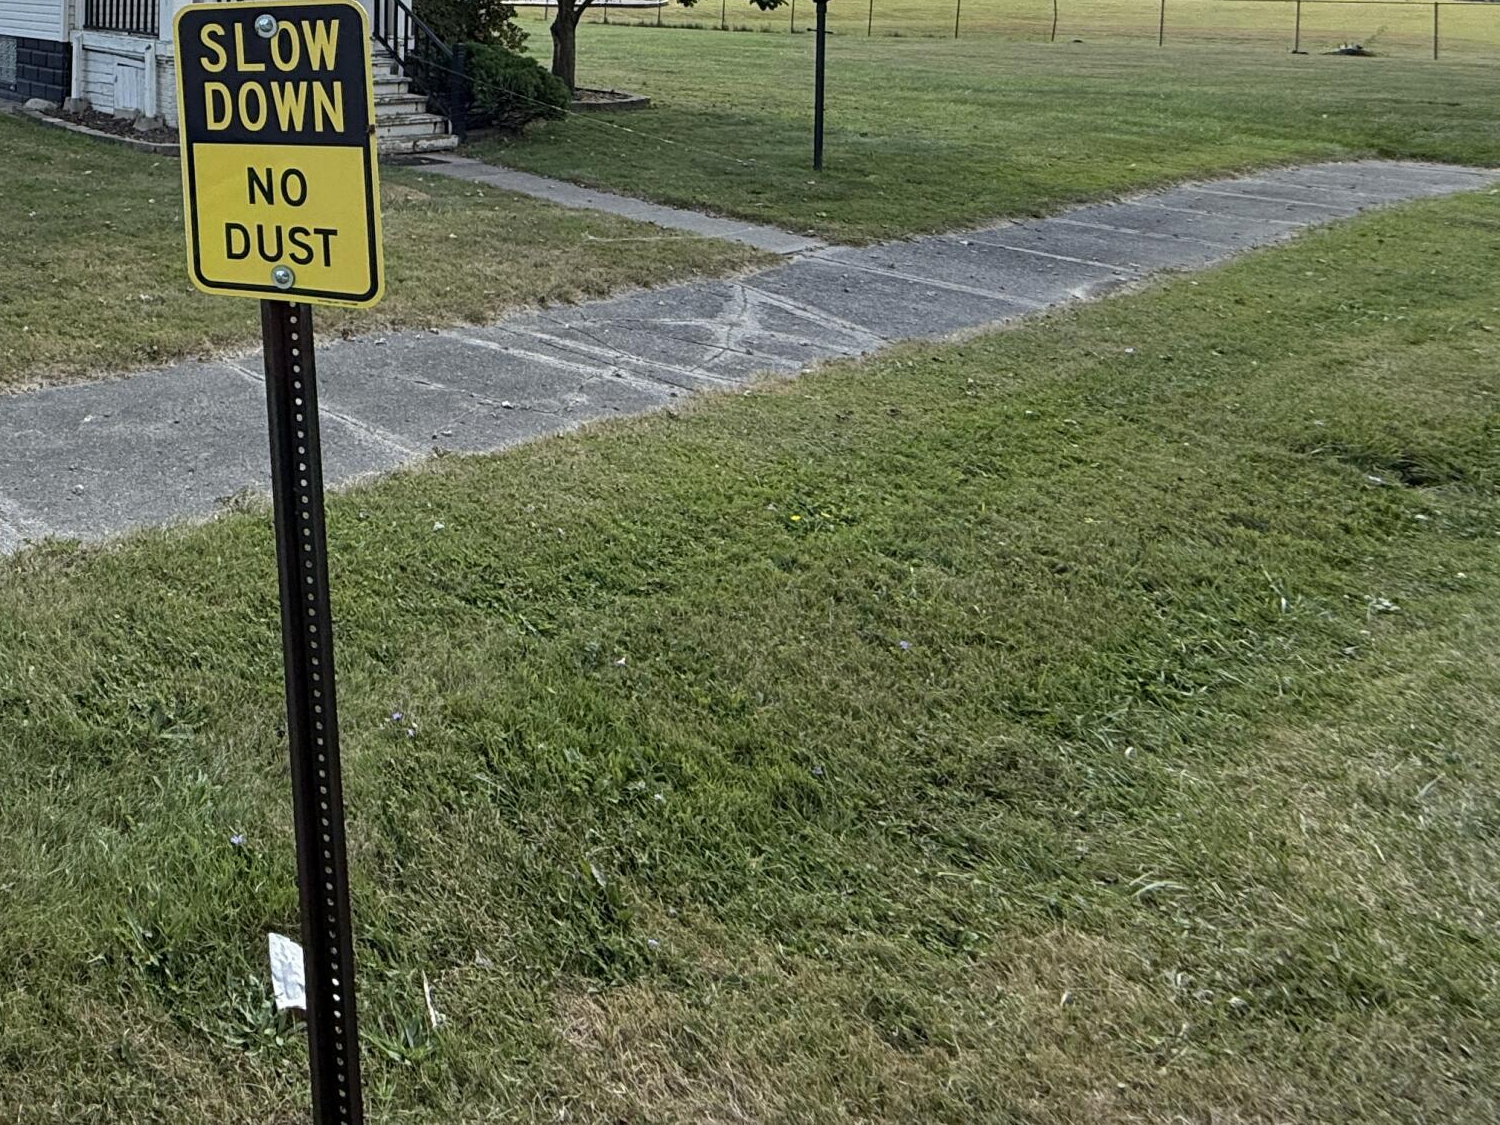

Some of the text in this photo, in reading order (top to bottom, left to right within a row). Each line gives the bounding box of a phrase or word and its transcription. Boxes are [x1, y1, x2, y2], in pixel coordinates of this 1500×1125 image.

[200, 19, 340, 72] SLOW
[204, 81, 344, 133] DOWN
[247, 167, 308, 207] NO
[225, 222, 338, 267] DUST
